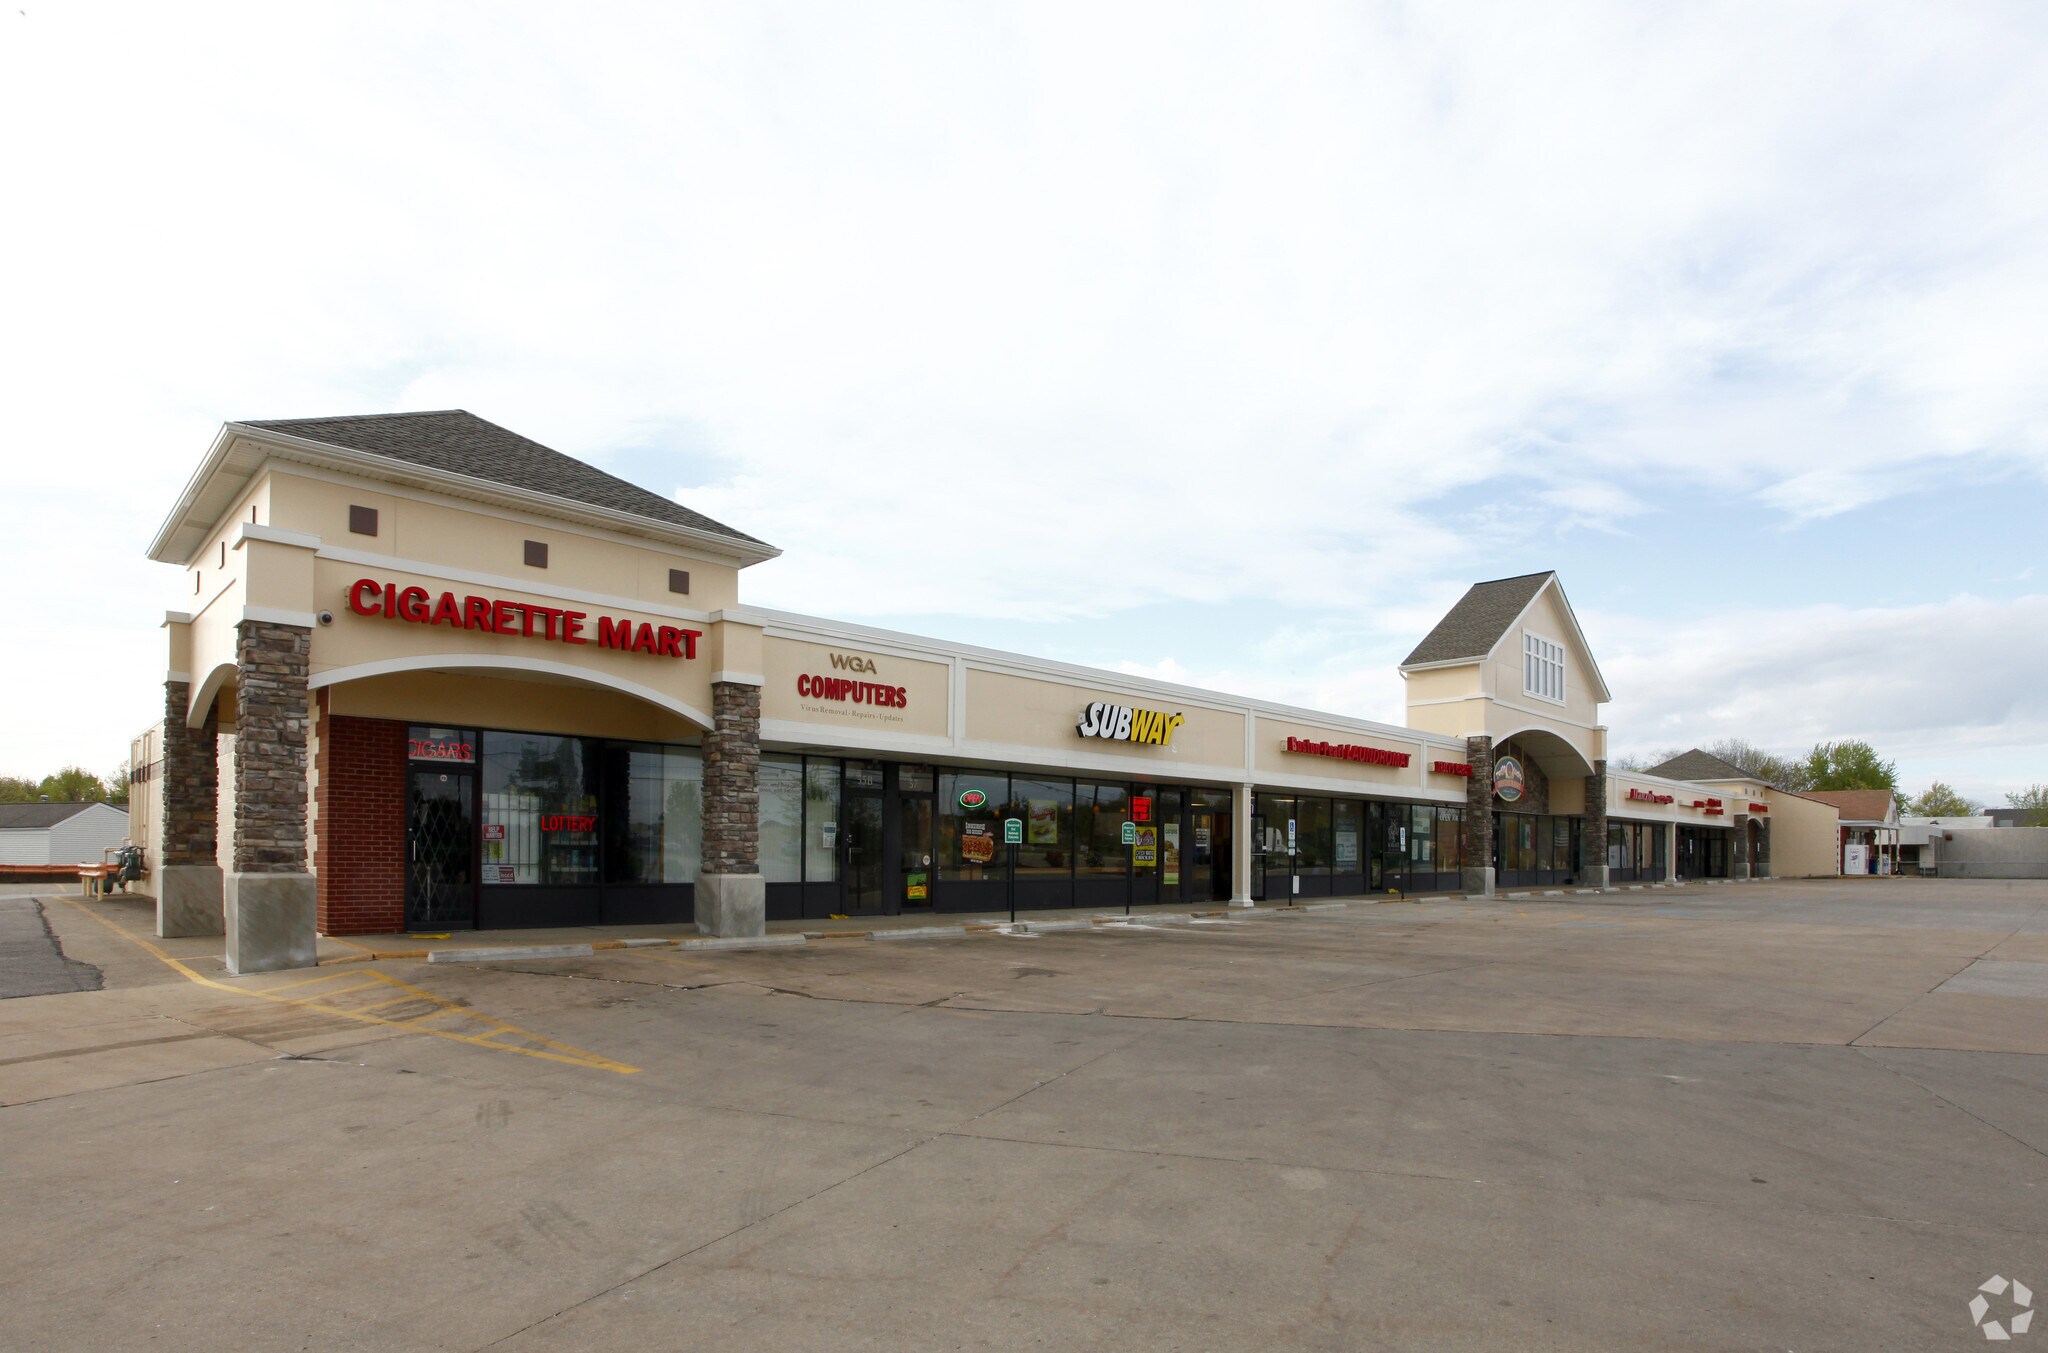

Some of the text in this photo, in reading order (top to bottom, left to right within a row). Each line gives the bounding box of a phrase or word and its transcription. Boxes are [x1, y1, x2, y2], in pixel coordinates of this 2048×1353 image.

[349, 578, 703, 660] CIGARETTE MART
[829, 653, 878, 675] WGA
[797, 673, 907, 709] COMPUTERS
[800, 703, 820, 713] Virus
[820, 706, 848, 716] Removal
[852, 710, 876, 720] Repairs
[1076, 701, 1185, 746] SUBWAY
[408, 739, 472, 761] CIGARS
[1344, 744, 1412, 768] LAUNDROMAT
[963, 793, 983, 803] OPEN
[541, 815, 595, 832] LOTTERY
